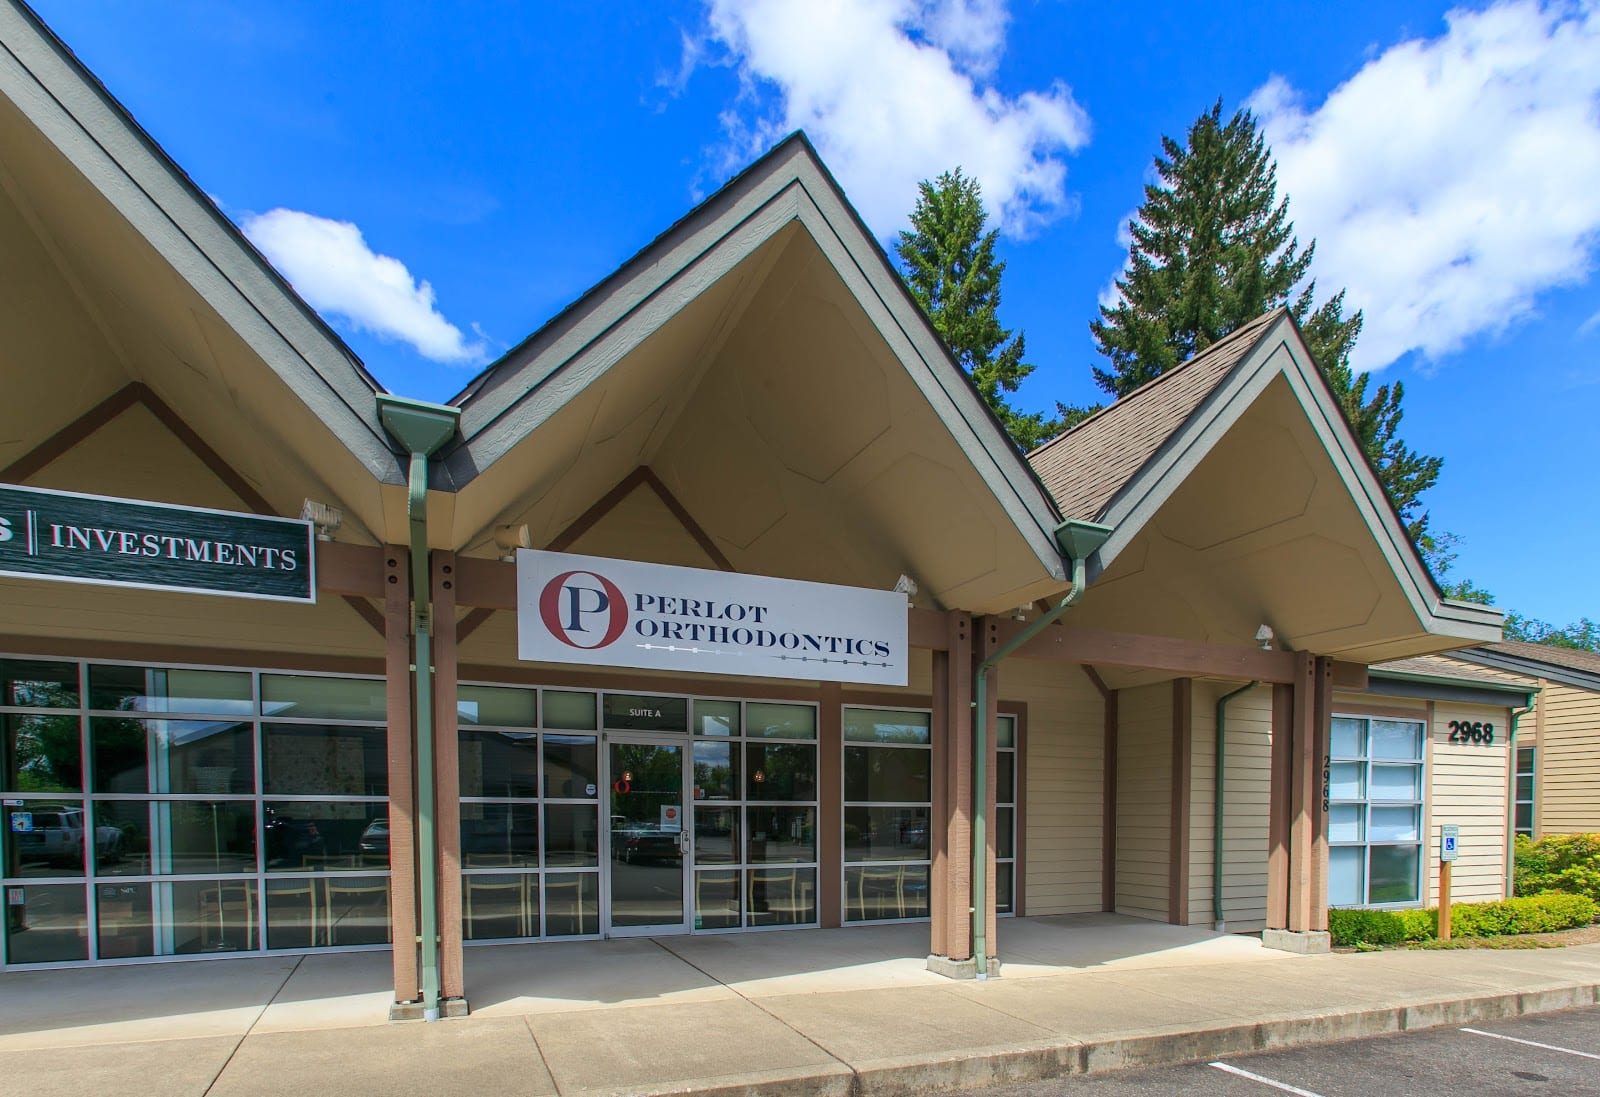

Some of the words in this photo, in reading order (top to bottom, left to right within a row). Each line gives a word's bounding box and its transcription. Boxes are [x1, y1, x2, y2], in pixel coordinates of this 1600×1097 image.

[50, 524, 297, 571] INVESTMENTS
[634, 593, 768, 623] PERLOT
[634, 619, 890, 657] ORTHODONTICS
[629, 708, 653, 717] SUITE
[1448, 720, 1494, 744] 2968
[1322, 755, 1330, 812] 2968
